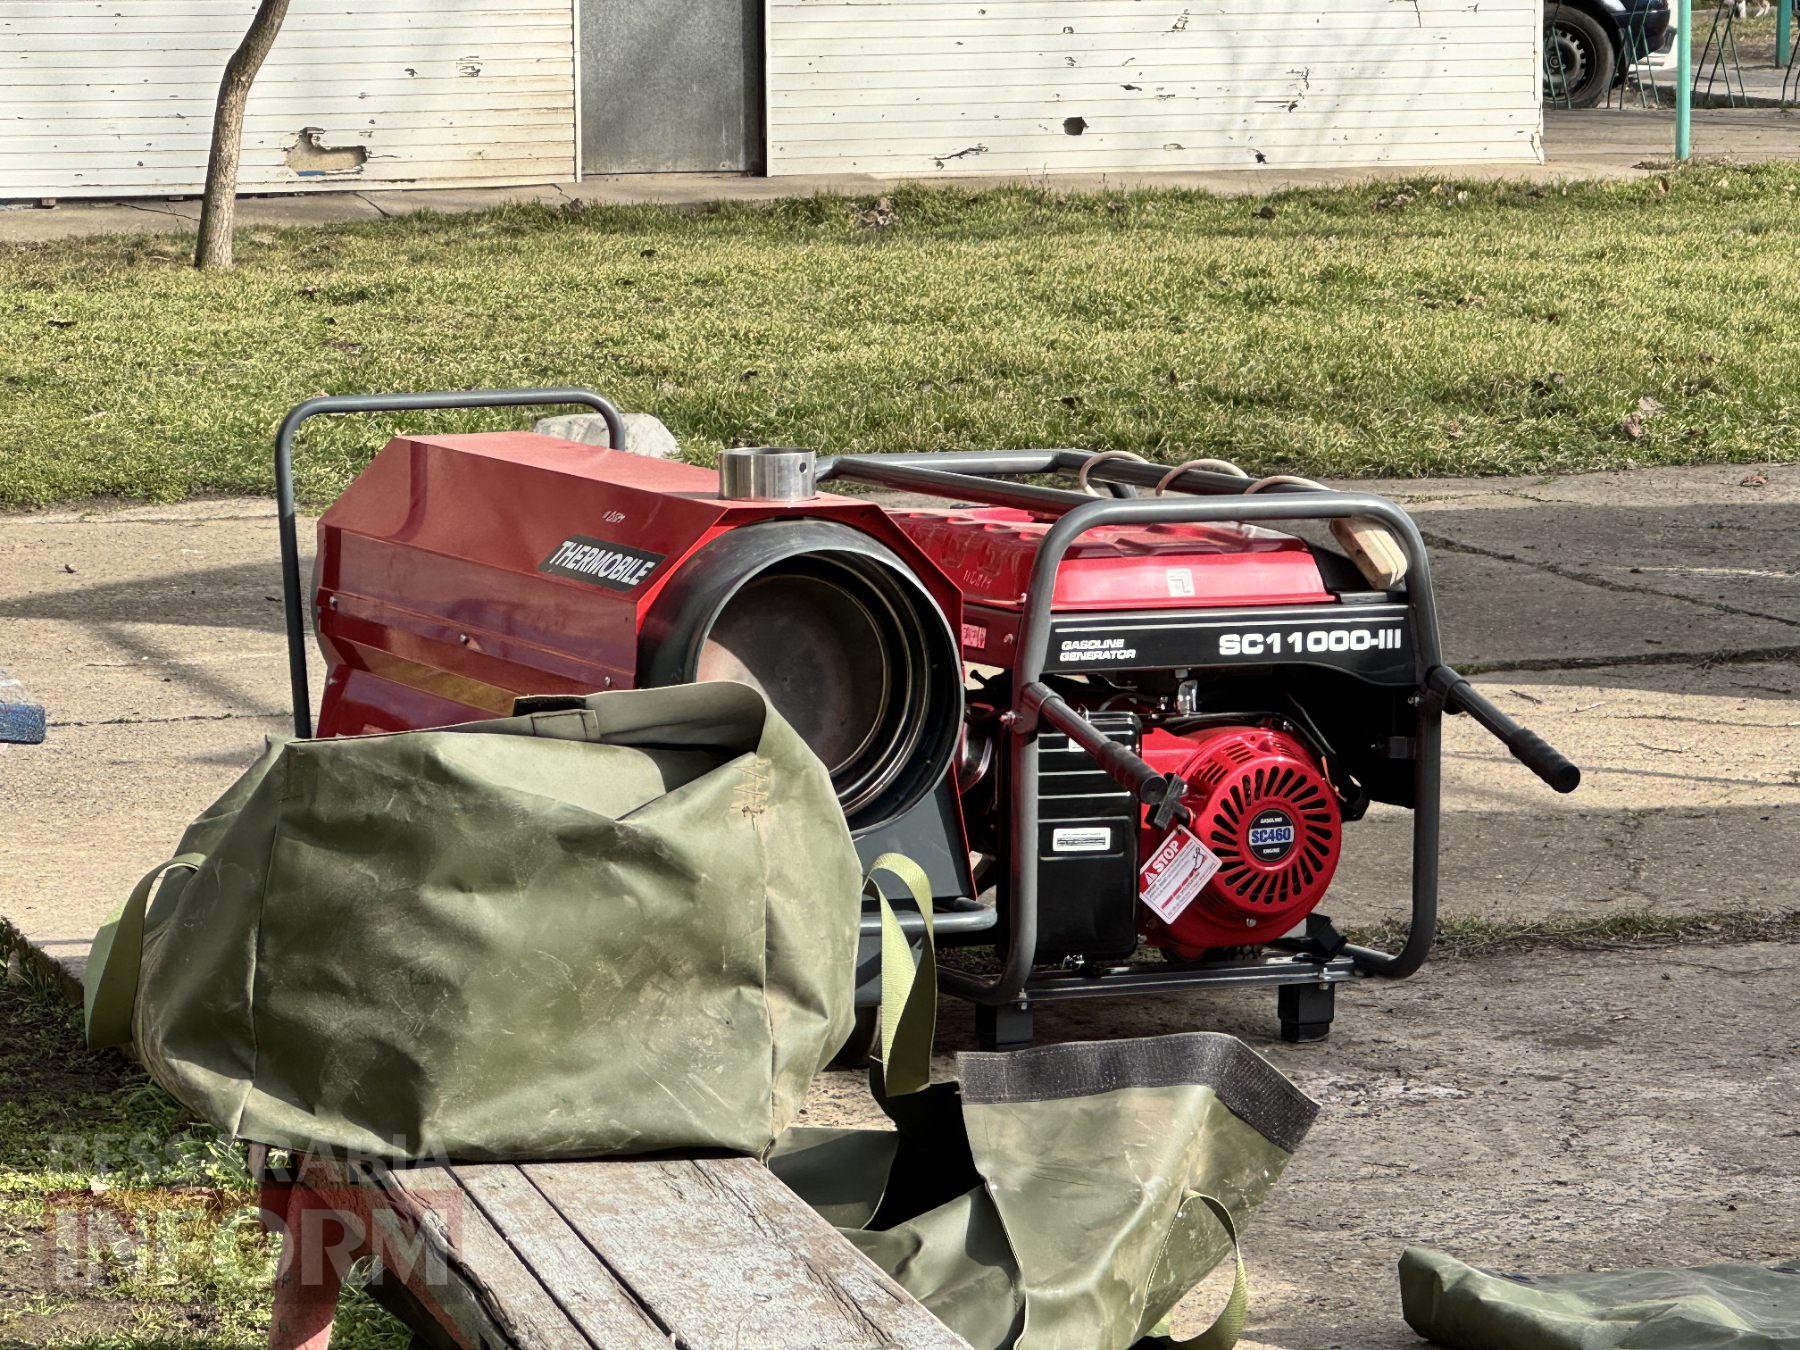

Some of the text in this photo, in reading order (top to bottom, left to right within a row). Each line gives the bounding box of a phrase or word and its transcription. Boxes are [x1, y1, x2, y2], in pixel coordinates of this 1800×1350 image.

[549, 541, 656, 585] THERMOBILE
[1061, 639, 1125, 650] GASOLINE
[1059, 649, 1136, 662] GENERATOR
[1251, 827, 1292, 844] SC460
[1152, 840, 1180, 873] STOP
